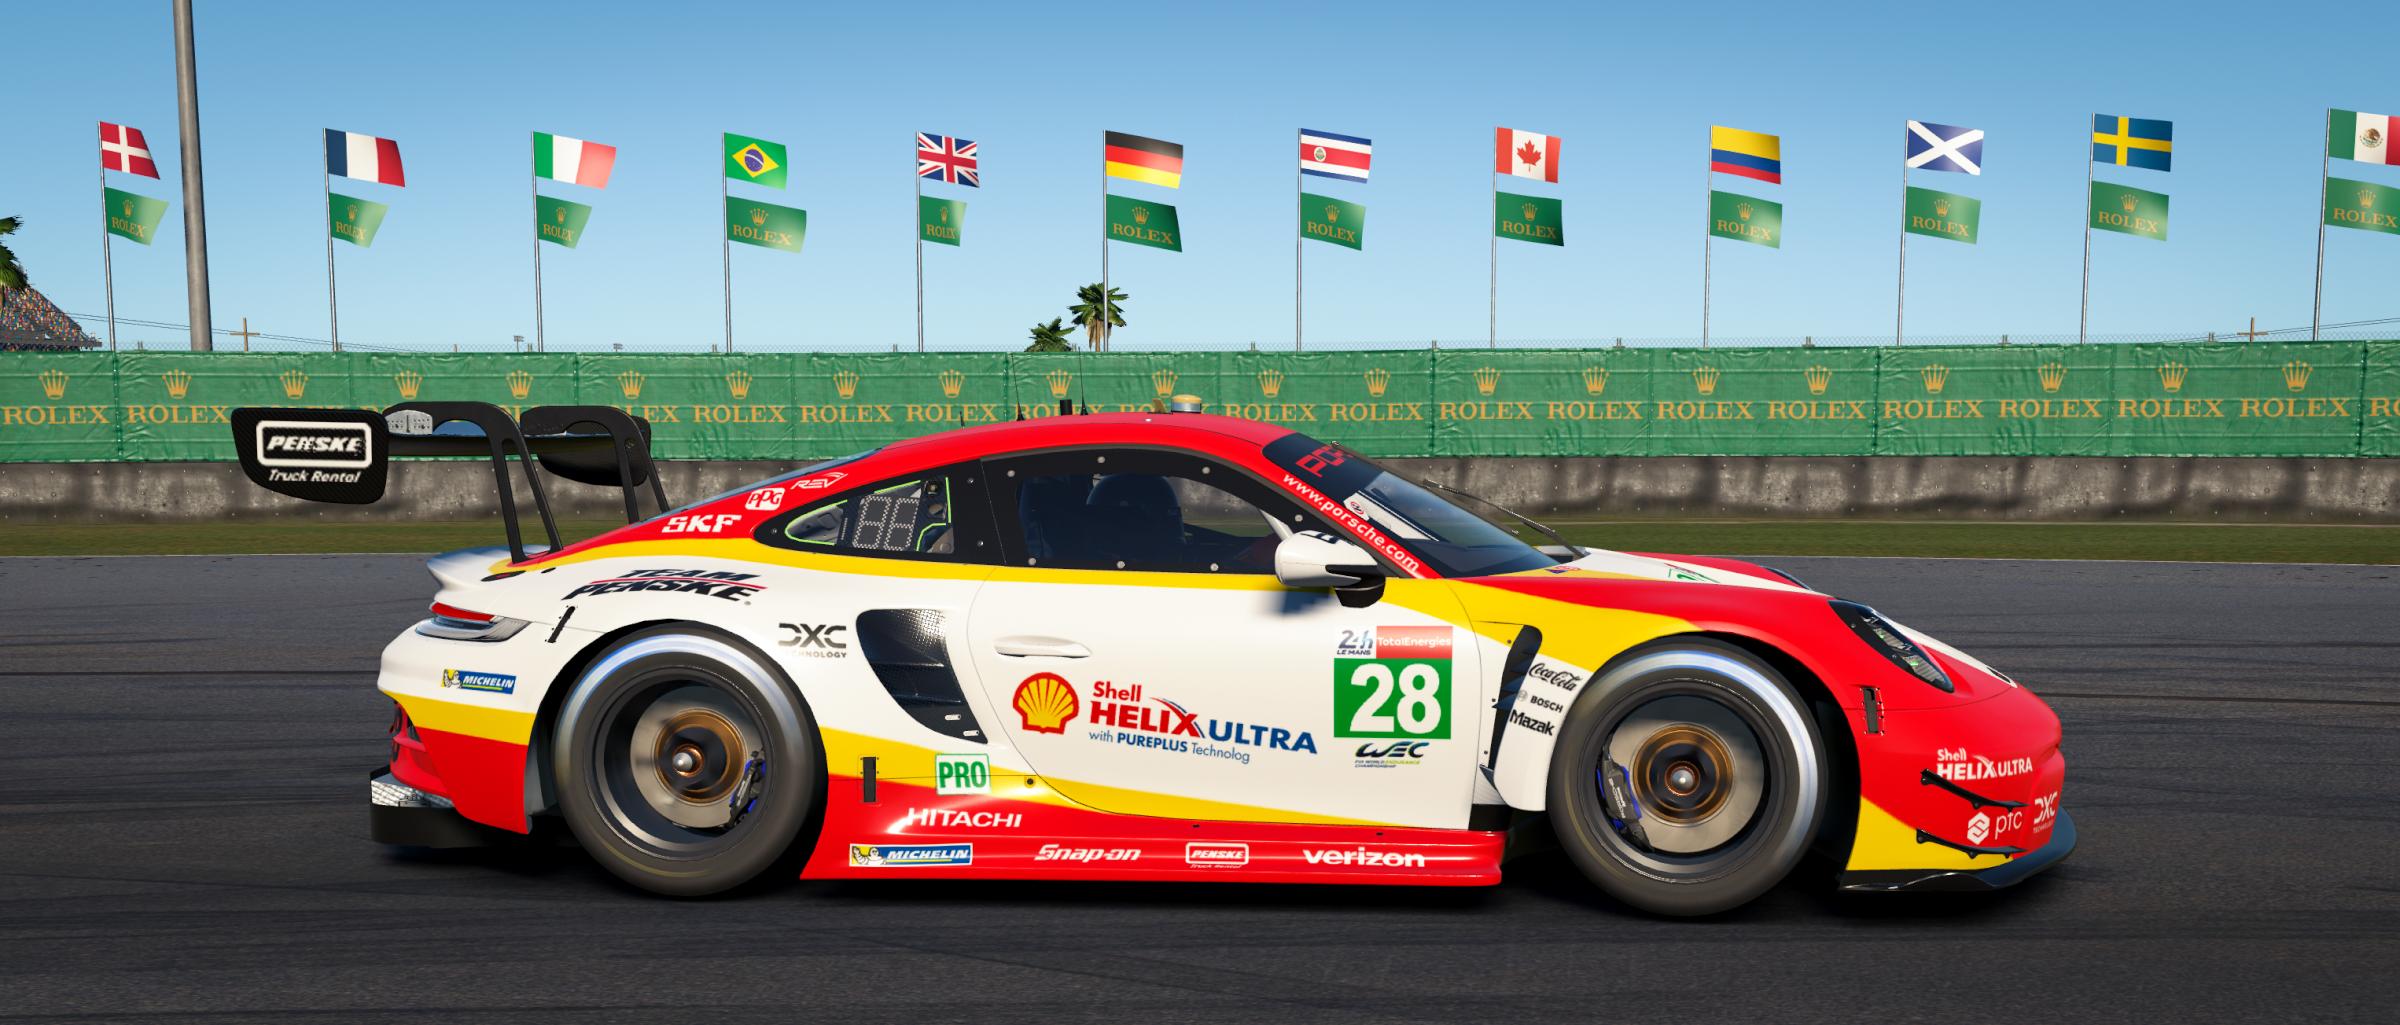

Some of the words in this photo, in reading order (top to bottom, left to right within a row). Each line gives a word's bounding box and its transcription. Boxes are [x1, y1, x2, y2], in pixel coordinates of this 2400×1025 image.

[112, 216, 145, 238] ROLEX
[1912, 216, 1969, 238] ROLEX
[2098, 210, 2158, 234] ROLEX
[2333, 207, 2399, 228] ROLEX
[733, 223, 792, 246] ROLEX
[1112, 222, 1174, 244] ROLEX
[1307, 220, 1356, 244] ROLEX
[1503, 219, 1557, 239] ROLEX
[1716, 218, 1772, 241] ROLEX
[3, 405, 109, 425] ROLEX
[127, 405, 230, 424] ROLEX
[693, 404, 786, 423] ROLEX
[800, 404, 894, 423] ROLEX
[906, 403, 997, 422] ROLEX
[1222, 403, 1318, 422] ROLEX
[1330, 402, 1423, 422] ROLEX
[1439, 401, 1533, 420] ROLEX
[1547, 400, 1643, 420] ROLEX
[1657, 400, 1753, 420] ROLEX
[1768, 399, 1866, 420] ROLEX
[1884, 399, 1984, 419] ROLEX
[1999, 399, 2101, 419] ROLEX
[2118, 398, 2224, 418] ROLEX
[2240, 398, 2350, 417] ROLEX
[267, 435, 363, 452] PENSKE
[268, 468, 309, 481] Truck
[311, 469, 362, 483] Rental
[746, 488, 786, 511] PPG
[661, 514, 742, 533] SKF
[1283, 473, 1422, 574] www.porsche.com
[615, 569, 761, 581] TEAM
[560, 579, 761, 602] PENSKE
[778, 622, 847, 649] DXC
[1376, 636, 1452, 650] TotalEnergies
[462, 675, 515, 689] MICHELIN
[1093, 681, 1143, 703] Shell
[1349, 662, 1442, 735] 28
[1530, 695, 1564, 714] BOSCH
[1089, 697, 1205, 739] HELIX
[1208, 718, 1318, 755] ULTRA
[1509, 708, 1556, 736] Mazak
[1089, 729, 1114, 743] with
[1117, 732, 1188, 753] PUREPLUS
[1191, 741, 1251, 765] Technolog
[1355, 740, 1430, 759] WEC
[1936, 747, 1967, 761] Shell
[938, 760, 987, 789] PRO
[1936, 754, 1997, 781] HELIX
[1997, 756, 2033, 778] ULTRA
[907, 807, 1023, 828] HITACHI
[1994, 810, 2023, 841] ptc
[886, 849, 969, 860] MICHELIN
[1033, 843, 1142, 863] Snap-on
[1190, 849, 1246, 859] PENSKE
[1302, 846, 1426, 868] verizon
